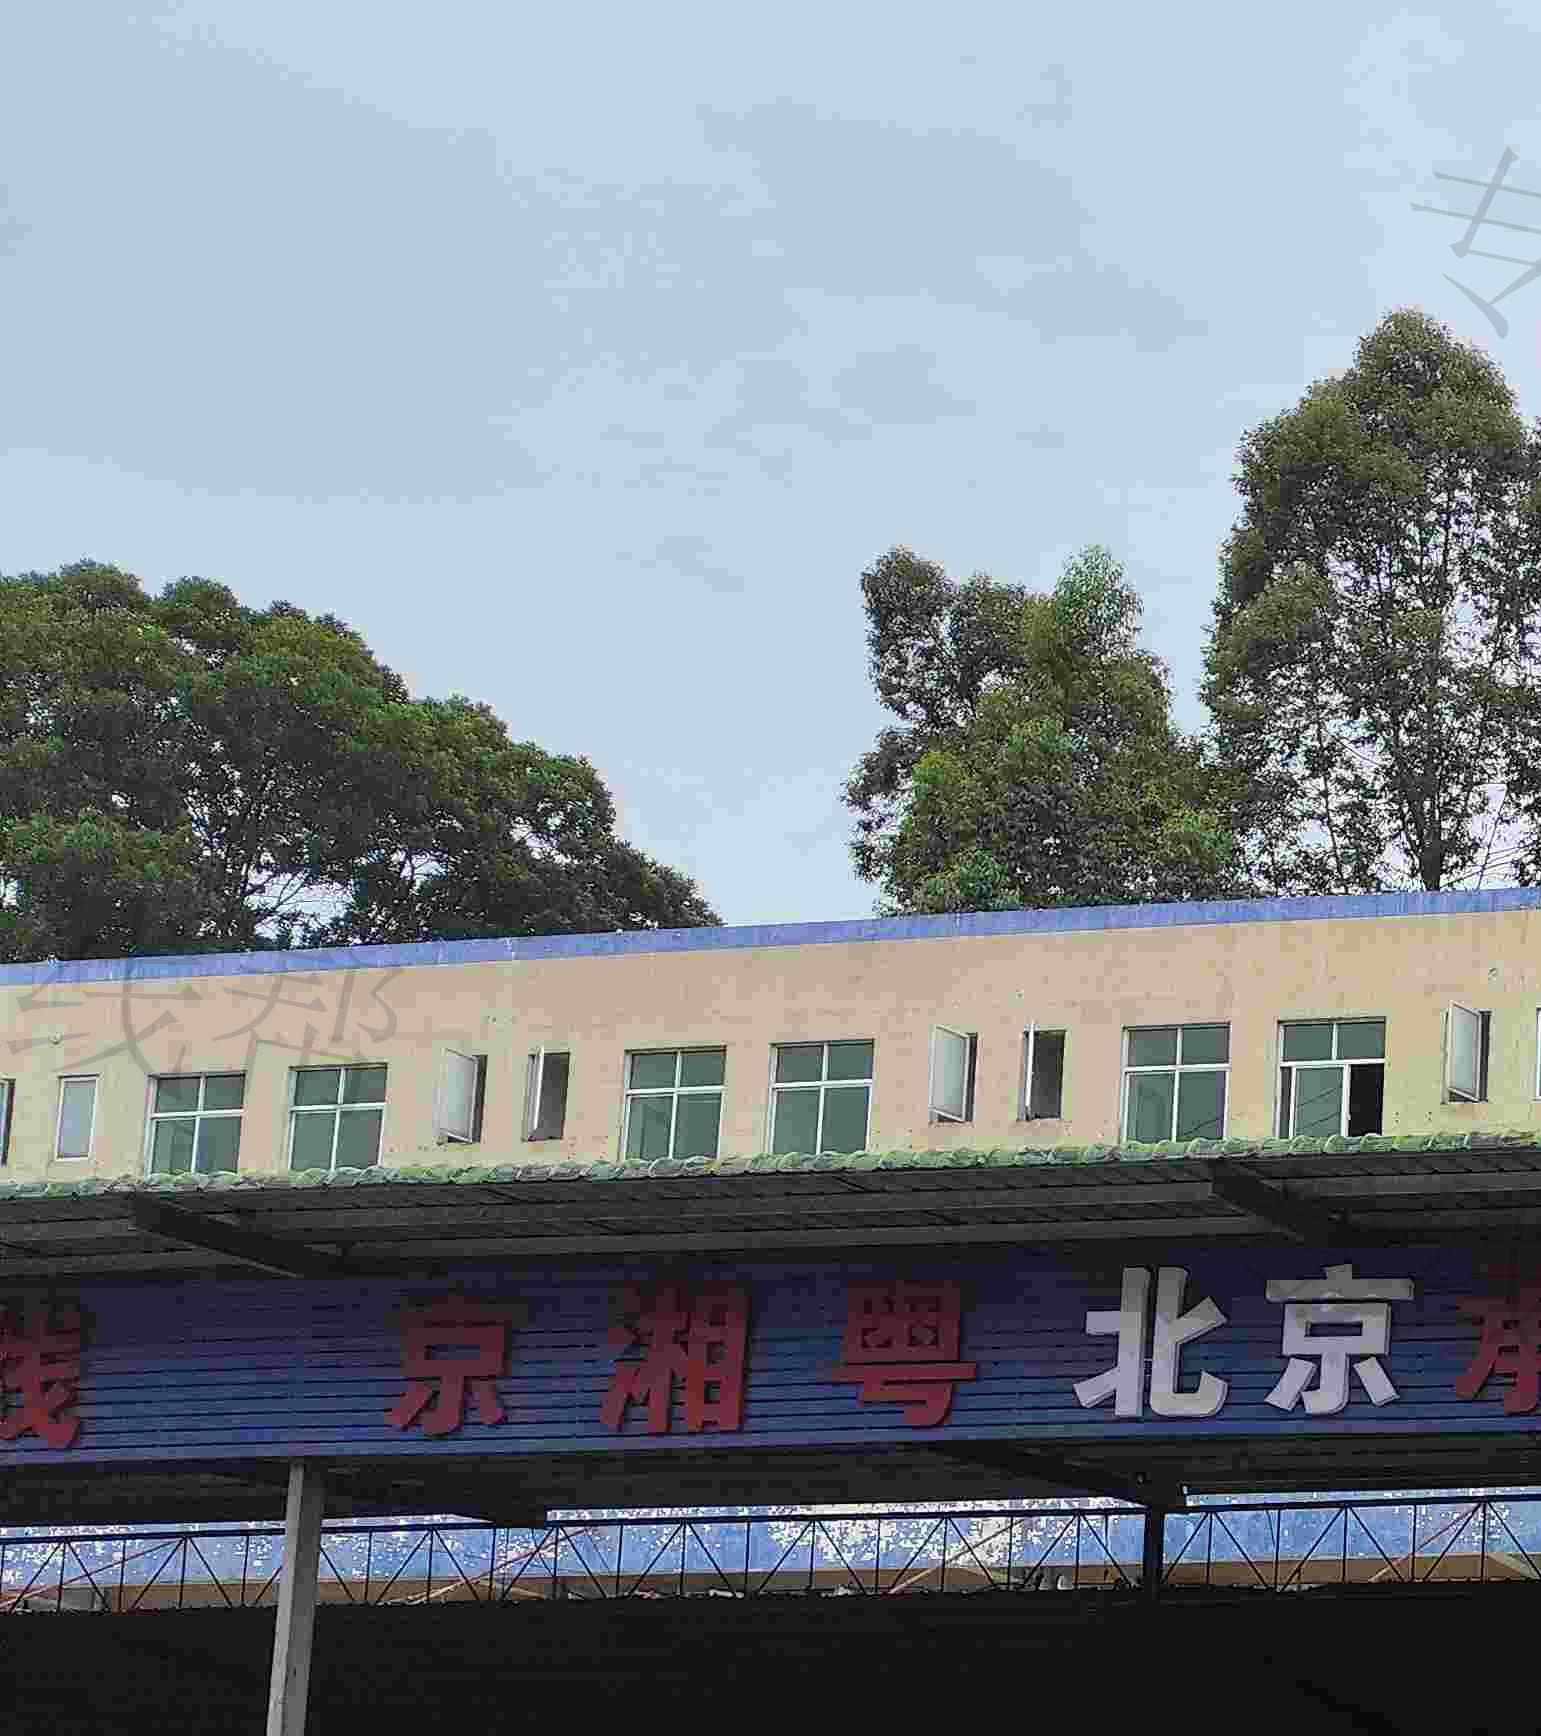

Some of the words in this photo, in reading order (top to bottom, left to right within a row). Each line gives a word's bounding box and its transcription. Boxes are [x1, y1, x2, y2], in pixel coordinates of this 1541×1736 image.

[384, 1279, 978, 1437] 京湘粤
[1071, 1262, 1415, 1418] 北京
